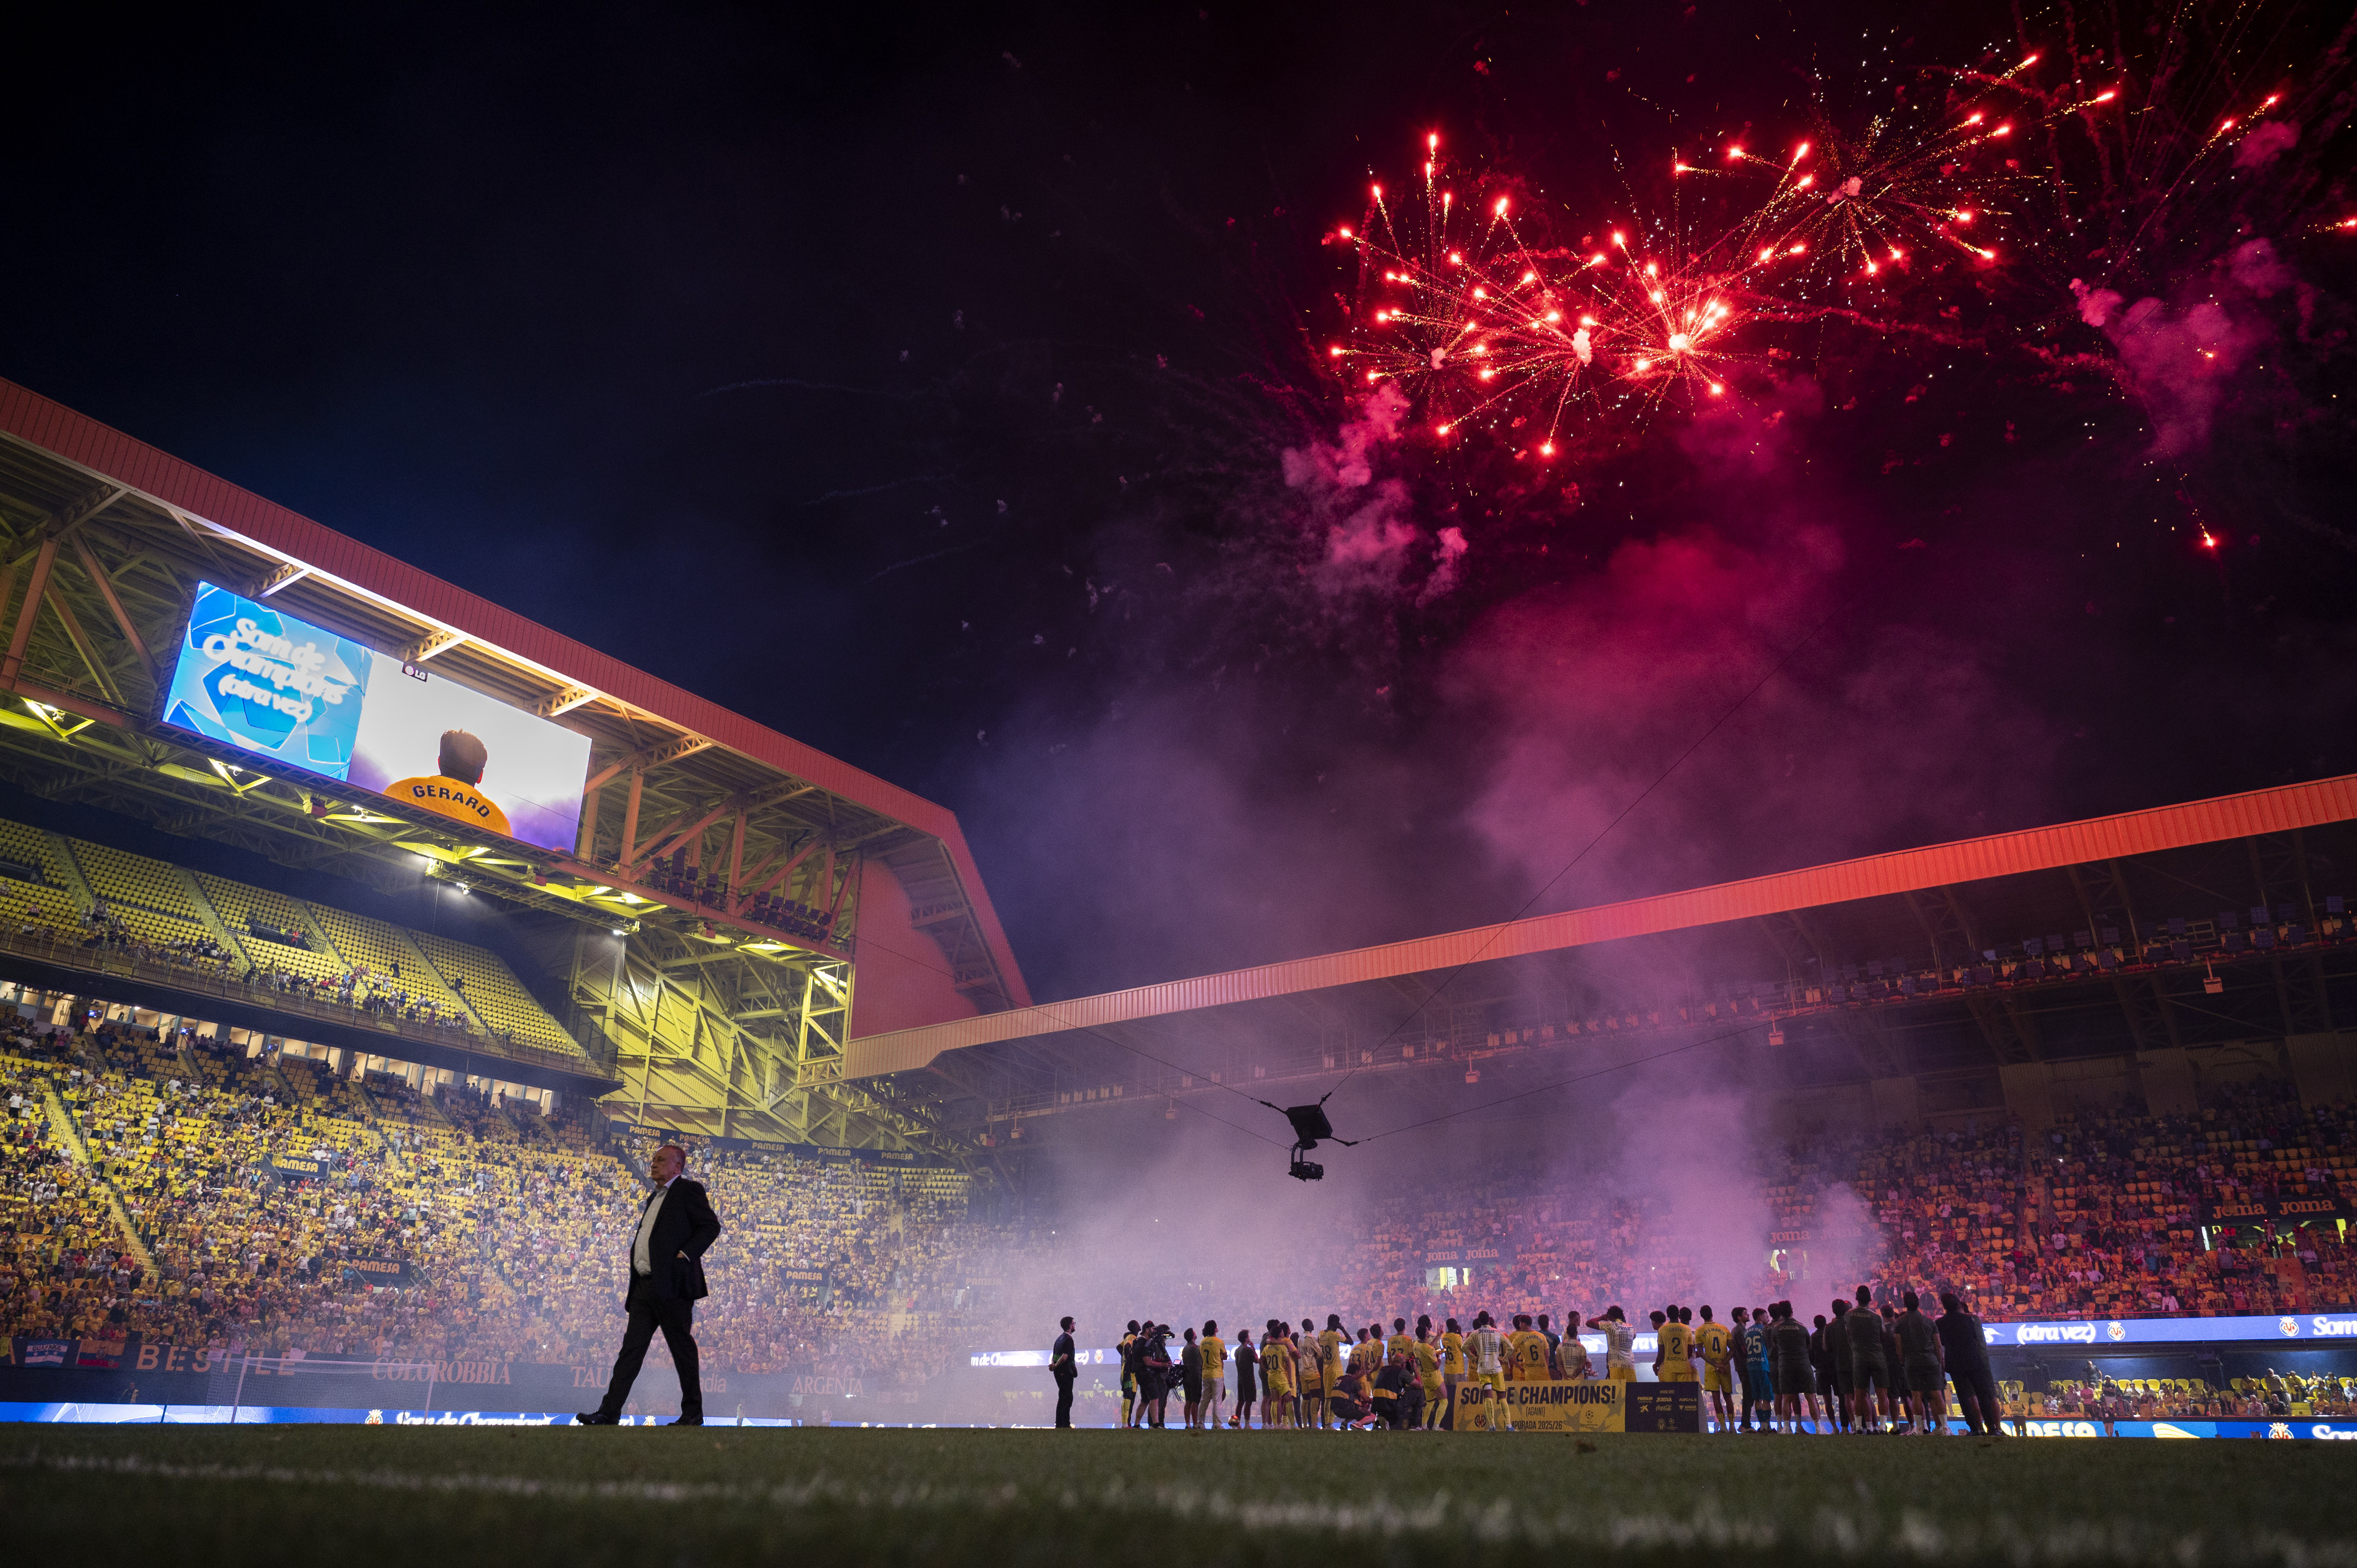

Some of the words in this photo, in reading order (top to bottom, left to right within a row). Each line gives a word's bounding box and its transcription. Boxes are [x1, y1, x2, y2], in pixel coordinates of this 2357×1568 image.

[230, 618, 293, 659] Som
[291, 642, 325, 670] de
[203, 634, 346, 704] Champions
[415, 669, 426, 680] LG
[218, 674, 273, 706] (otra
[273, 694, 312, 722] vez)
[412, 785, 490, 818] GERARD
[629, 1125, 660, 1137] PAMESA
[752, 1142, 784, 1151] PAMESA
[818, 1147, 851, 1156] PAMESA
[279, 1158, 319, 1172] AMESA
[2279, 1200, 2336, 1215] Joma
[1426, 1251, 1459, 1263] Joma
[352, 1259, 400, 1274] PAMESA
[786, 1271, 822, 1280] PAMESA
[2017, 1323, 2060, 1345] (otra
[2059, 1322, 2096, 1344] vez)
[1529, 1345, 1539, 1361] 6
[1672, 1337, 1681, 1354] 2
[1712, 1336, 1721, 1354] 4
[1745, 1335, 1761, 1355] 25
[1075, 1350, 1089, 1366] ez)
[1204, 1349, 1210, 1365] 7
[1266, 1354, 1278, 1370] 20
[372, 1357, 511, 1385] COLOROBBIA
[791, 1376, 863, 1394] ARGENTA
[1519, 1385, 1616, 1405] CHAMPIONS!
[1526, 1406, 1545, 1417] (AGAIN!)
[1503, 1420, 1536, 1430] TMPORADA
[1538, 1420, 1562, 1430] 2025/26
